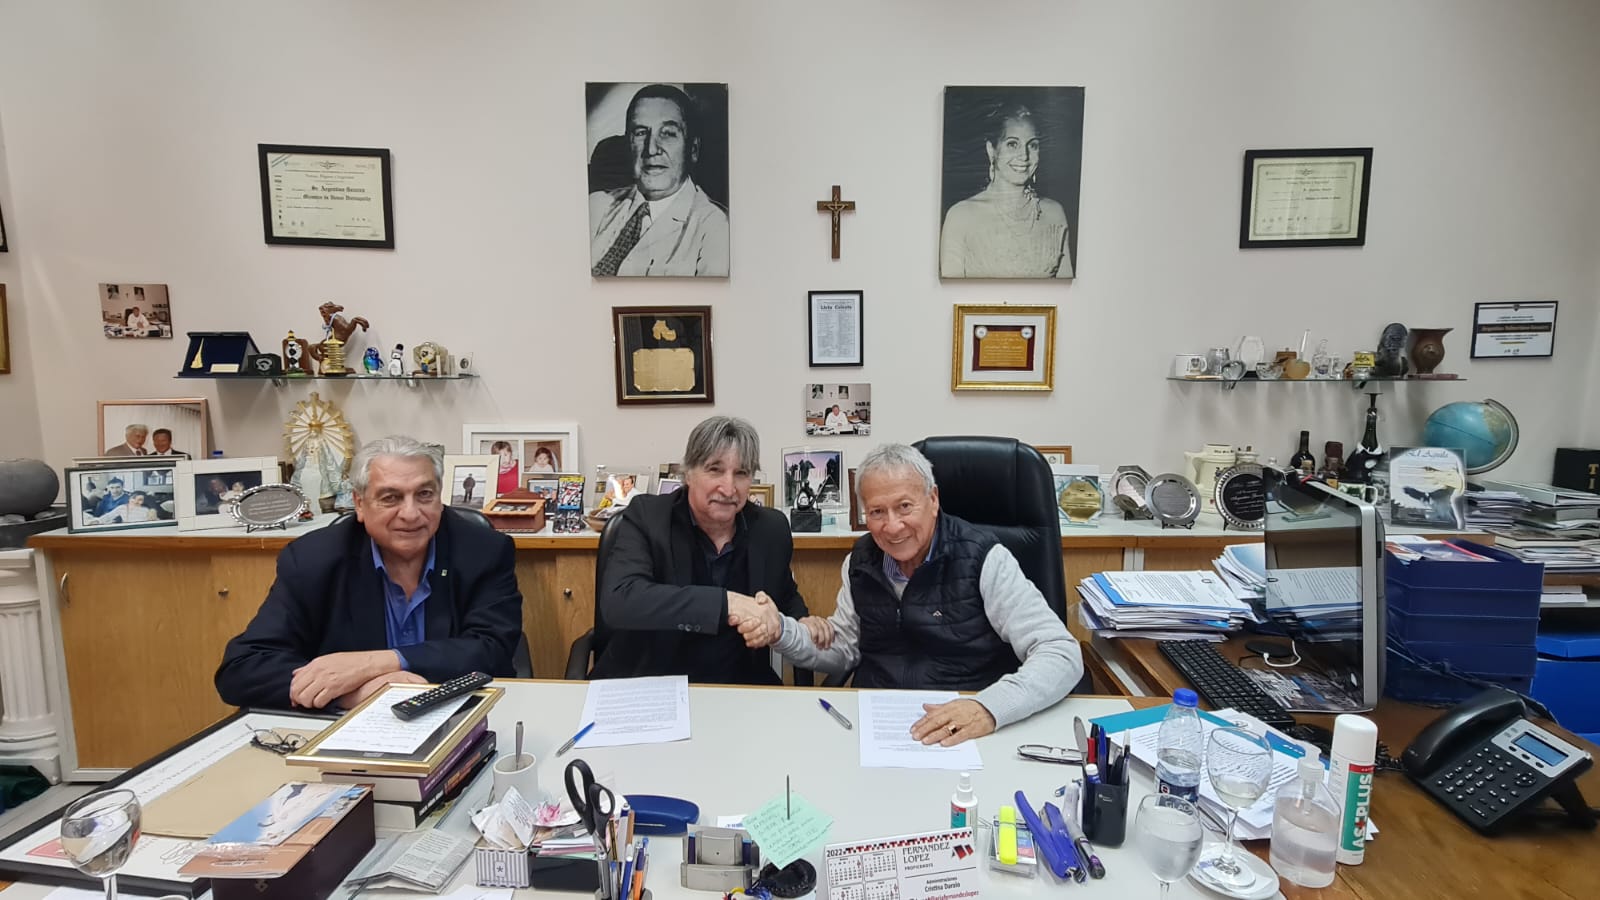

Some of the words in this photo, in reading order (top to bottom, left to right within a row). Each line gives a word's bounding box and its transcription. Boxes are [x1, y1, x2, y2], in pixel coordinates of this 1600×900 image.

[826, 848, 843, 858] 2022
[902, 842, 950, 856] FERNANDEZ
[903, 853, 930, 864] LOPEZ
[924, 885, 944, 893] Cristina
